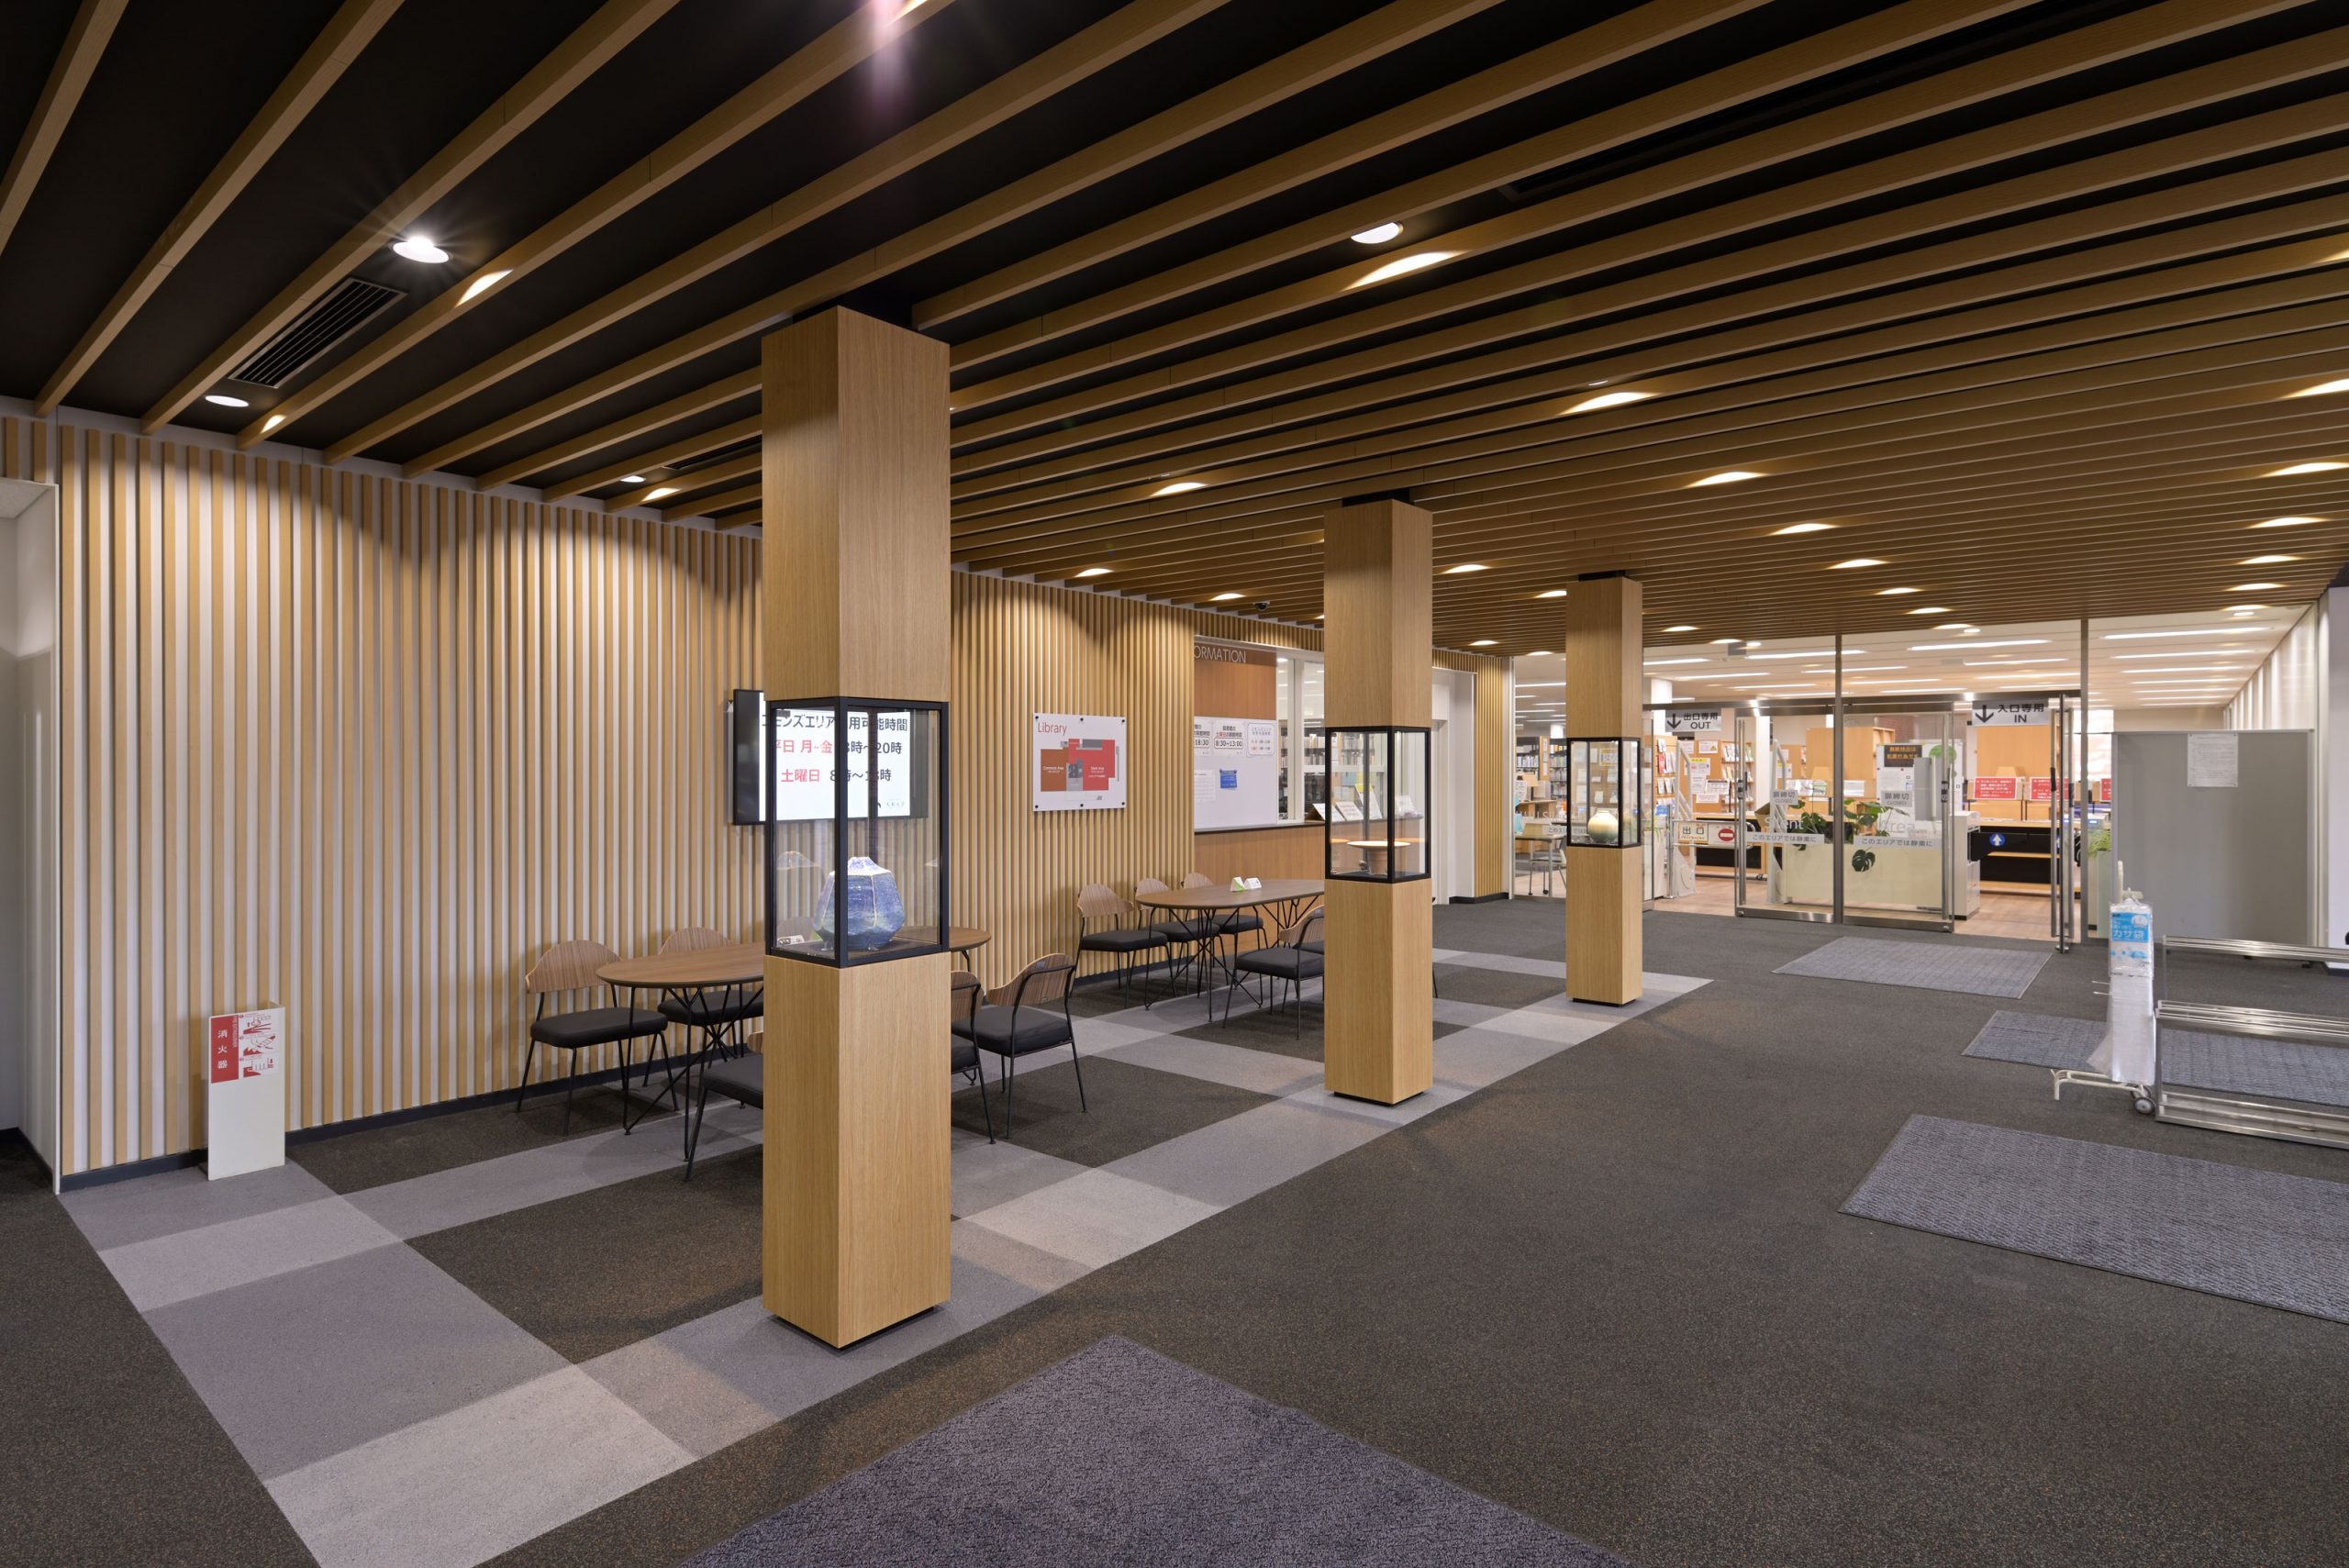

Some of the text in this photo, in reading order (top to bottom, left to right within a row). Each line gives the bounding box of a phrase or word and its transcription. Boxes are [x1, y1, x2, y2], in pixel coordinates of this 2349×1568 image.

[1998, 703, 2044, 713] 入口専用
[1684, 712, 1718, 720] 出口専用
[2014, 715, 2027, 723] IN
[1038, 722, 1068, 736] Library
[781, 769, 820, 783] 土曜日
[1683, 826, 1704, 835] 出口
[217, 1029, 228, 1070] 消火器
